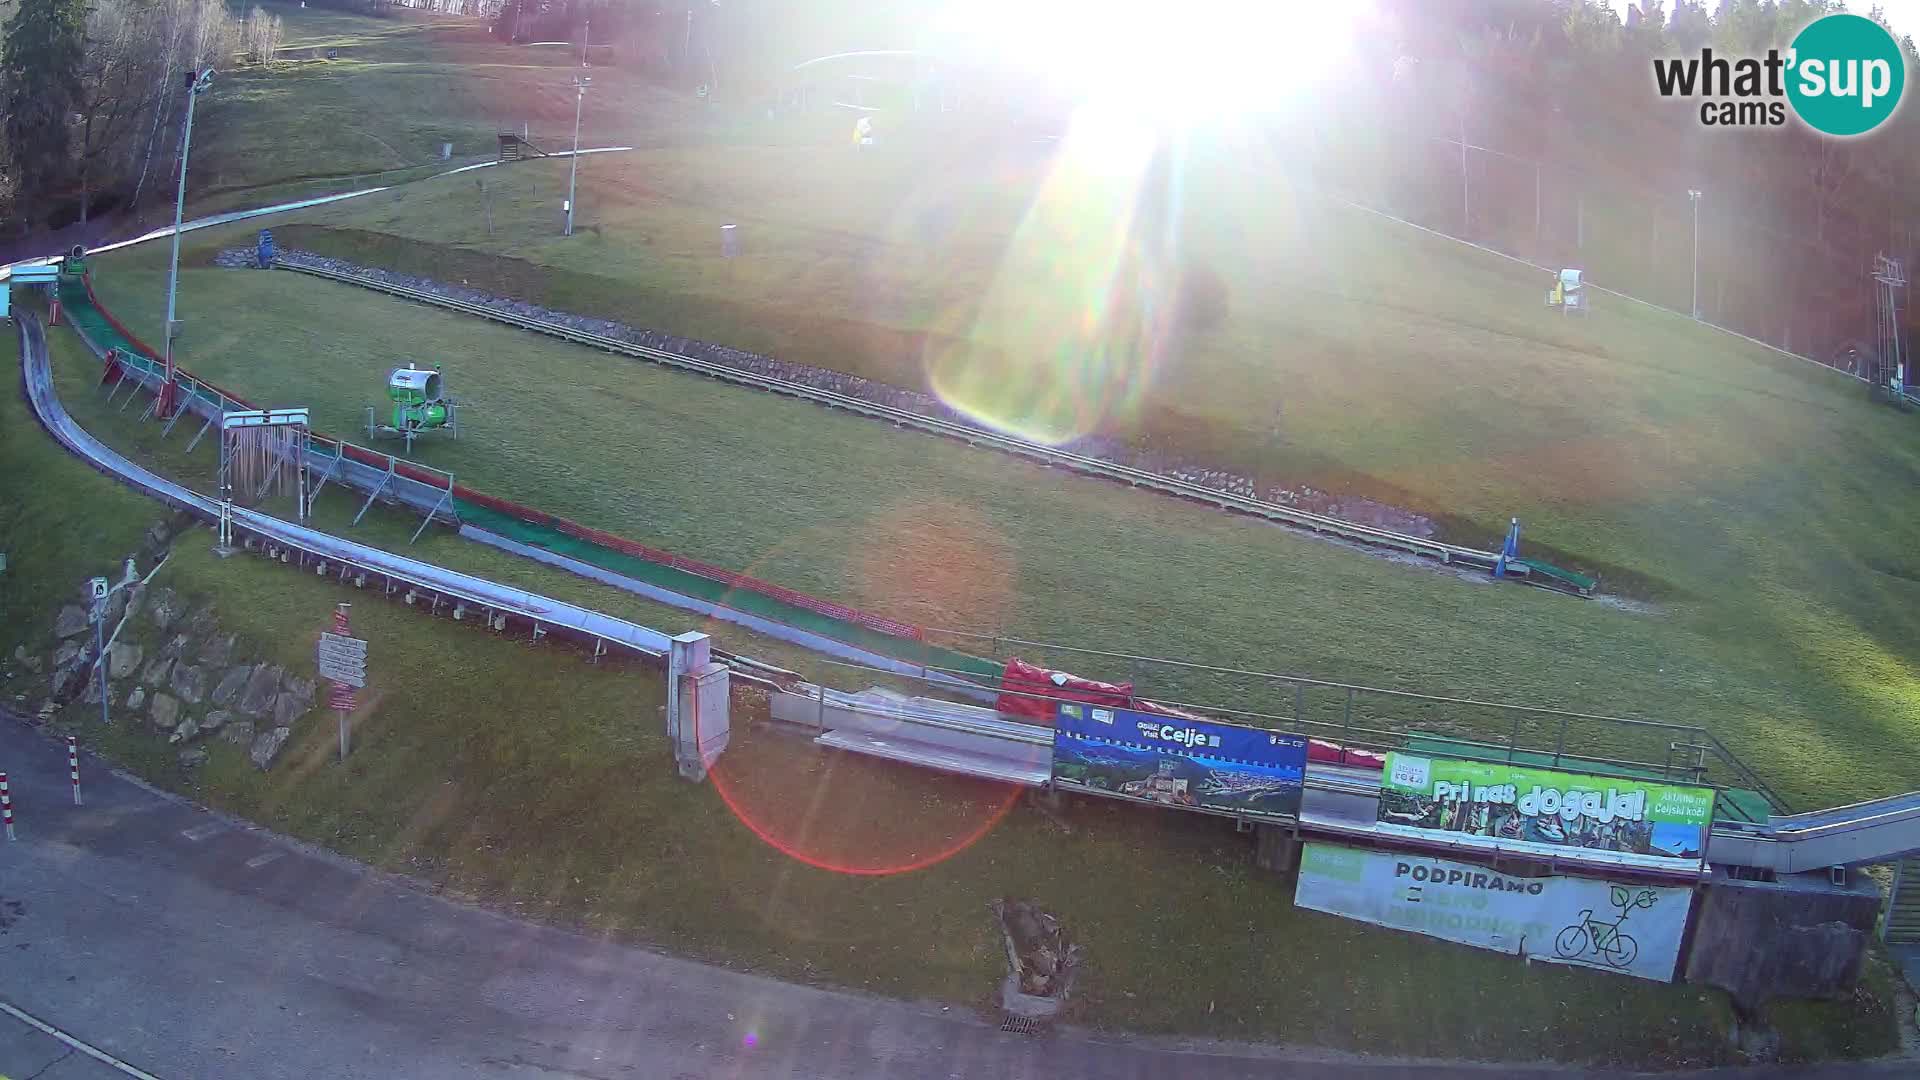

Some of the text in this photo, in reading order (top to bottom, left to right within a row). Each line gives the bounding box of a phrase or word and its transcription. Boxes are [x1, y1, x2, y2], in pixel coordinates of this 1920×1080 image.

[1142, 730, 1159, 739] Visit
[1160, 725, 1206, 748] Celje
[1432, 780, 1646, 824] Pri nas dogaja!
[1396, 862, 1543, 895] PODPIRAMO
